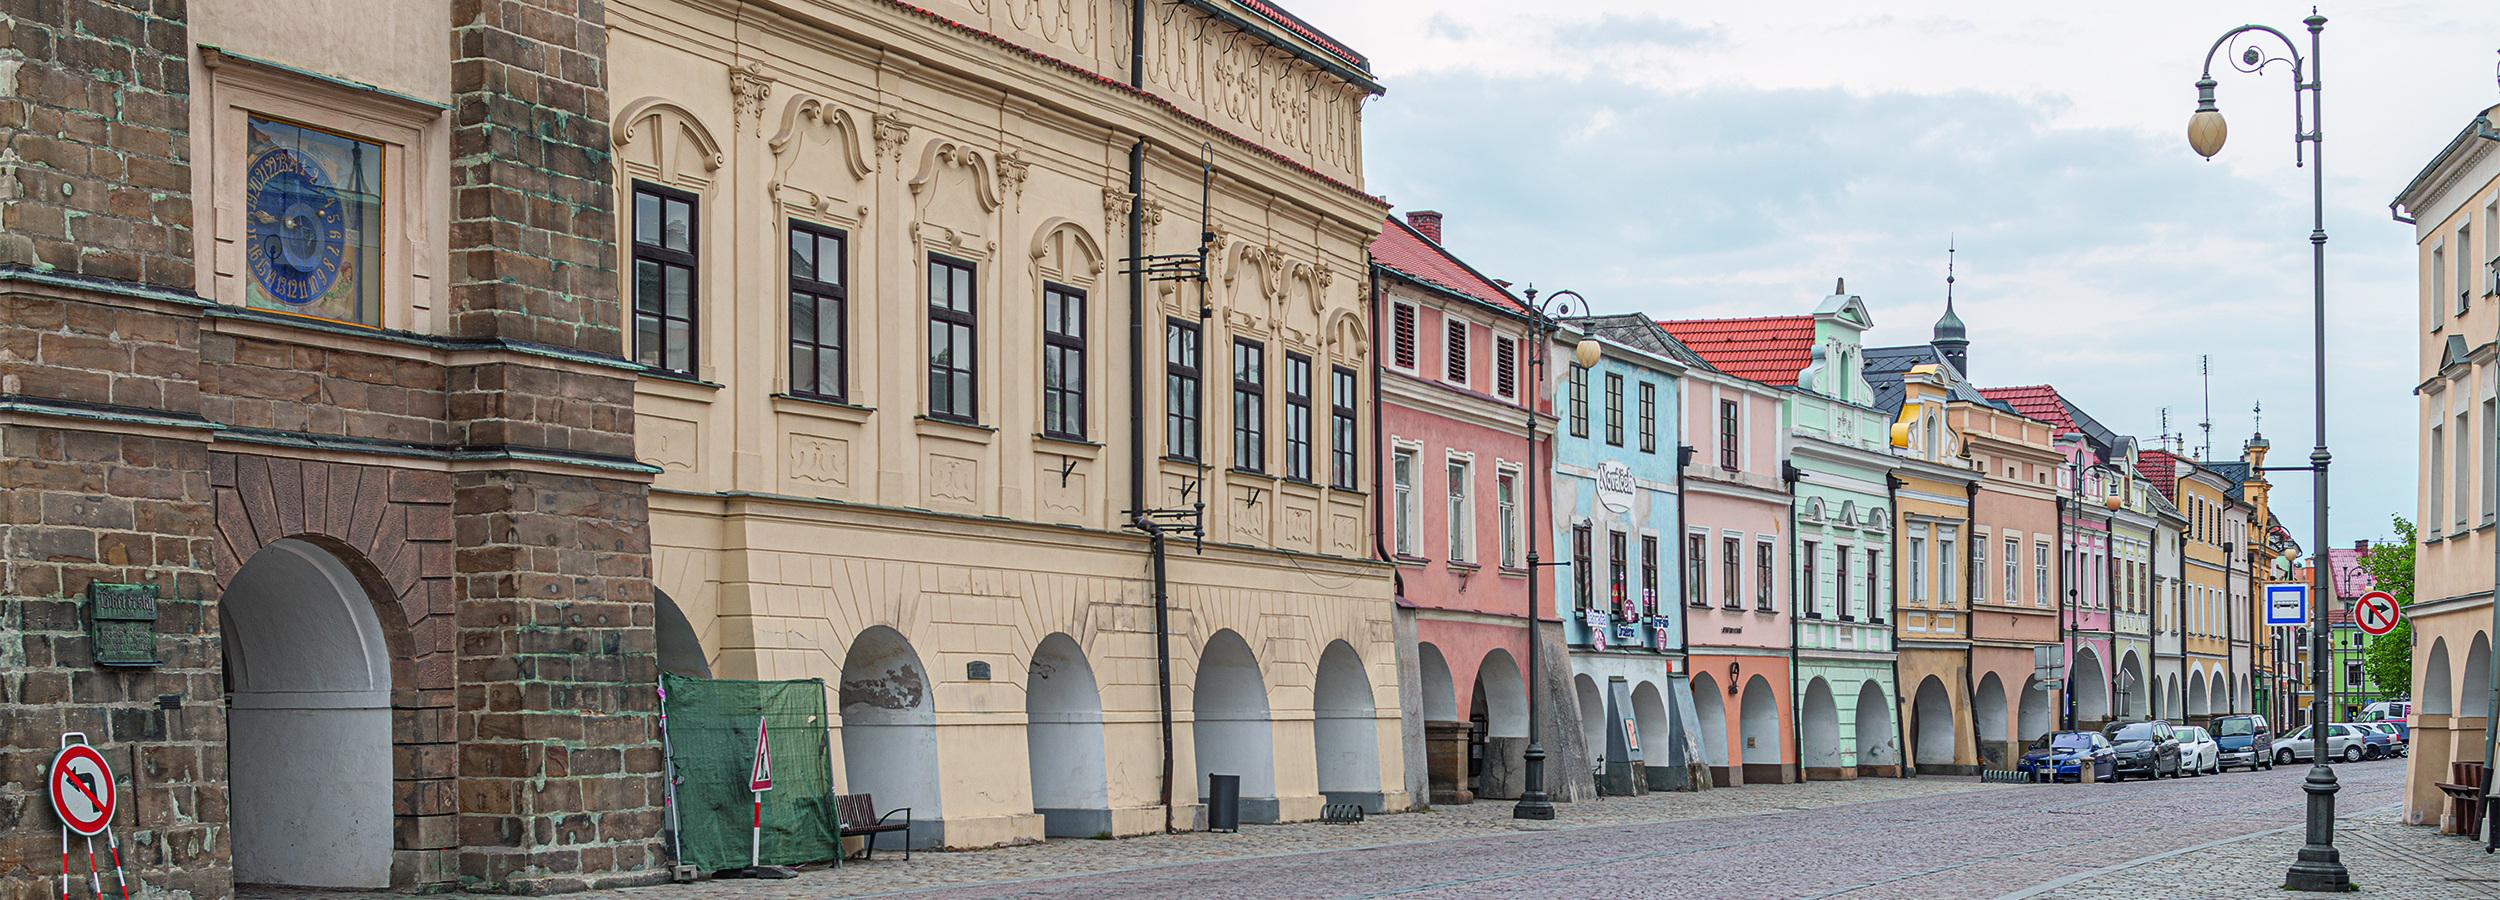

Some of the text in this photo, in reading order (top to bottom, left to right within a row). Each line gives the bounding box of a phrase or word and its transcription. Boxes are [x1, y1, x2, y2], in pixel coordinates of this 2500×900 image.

[264, 156, 279, 178] 22
[274, 153, 288, 172] 23
[288, 152, 298, 174] 24
[301, 159, 306, 176] 1
[254, 163, 270, 185] 21
[309, 168, 319, 184] 2
[248, 176, 264, 198] 20
[247, 191, 258, 210] 19
[326, 214, 340, 224] 5
[330, 230, 342, 239] 6
[248, 244, 264, 261] 16
[326, 246, 340, 257] 7
[254, 258, 270, 276] 15
[322, 257, 336, 272] 8
[264, 268, 278, 288] 14
[274, 276, 287, 296] 13
[308, 275, 320, 296] 10
[316, 268, 328, 286] 9
[287, 280, 298, 298] 12
[298, 280, 308, 299] 11
[1598, 462, 1633, 495] Nováček
